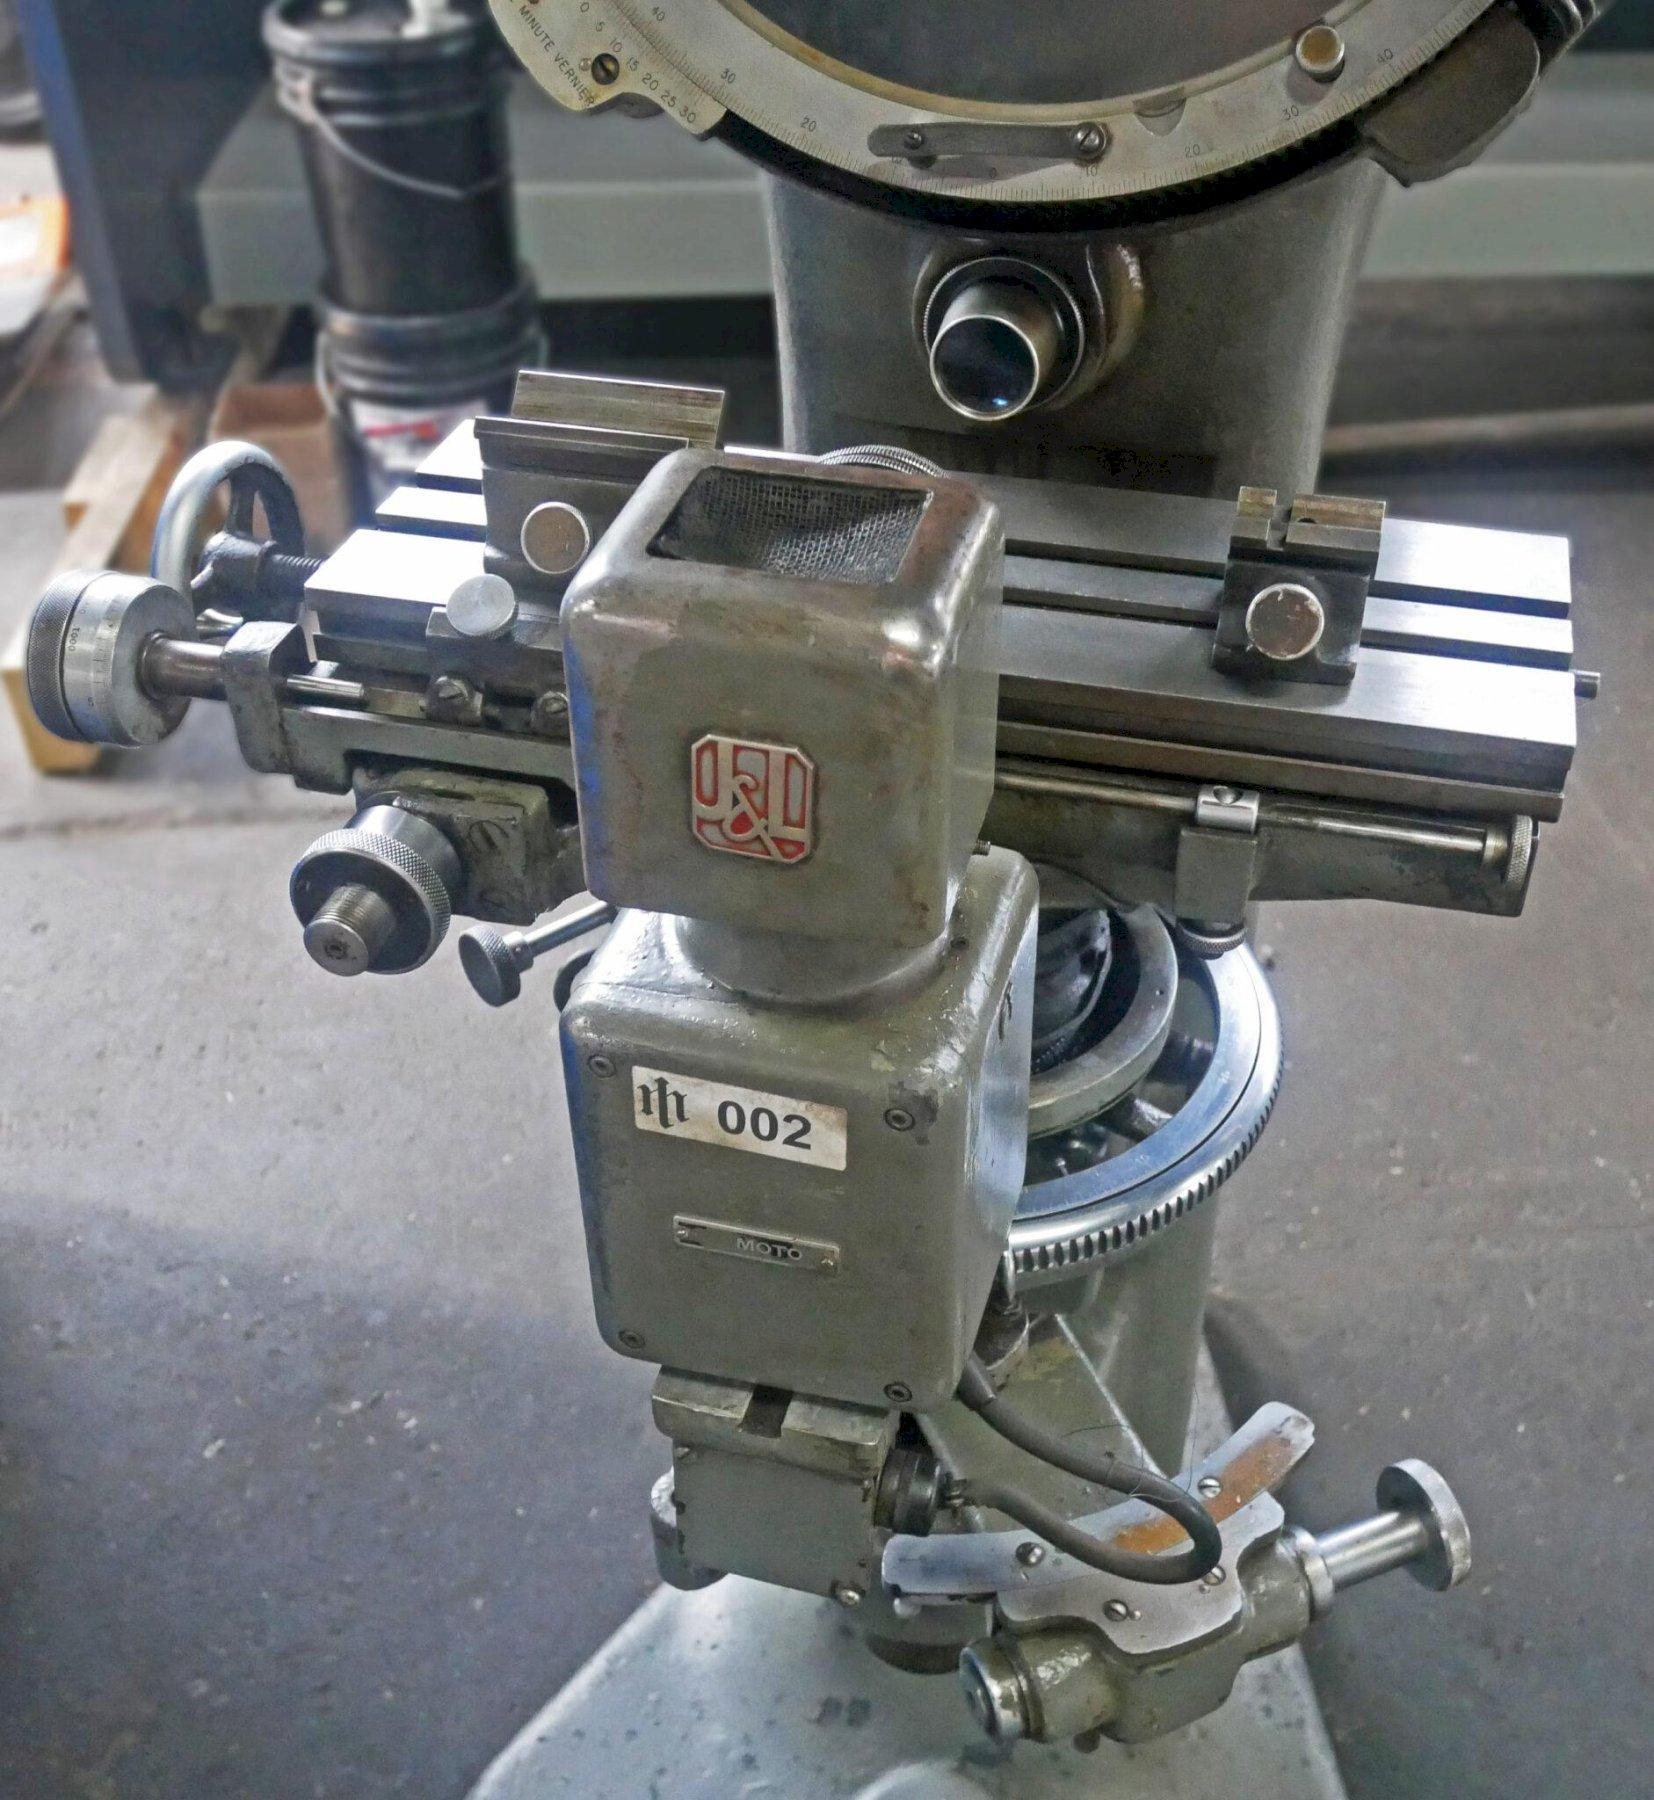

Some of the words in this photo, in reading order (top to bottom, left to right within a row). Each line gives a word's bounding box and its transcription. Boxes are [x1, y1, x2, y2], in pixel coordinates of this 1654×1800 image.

[519, 5, 555, 52] MINUTE
[554, 53, 595, 105] VERNIER
[642, 72, 659, 91] 20
[660, 89, 676, 108] 25
[679, 105, 697, 124] 30
[720, 68, 736, 84] 30
[800, 117, 817, 132] 20
[1184, 143, 1201, 159] 20
[1282, 104, 1300, 121] 30
[717, 1099, 812, 1150] 002
